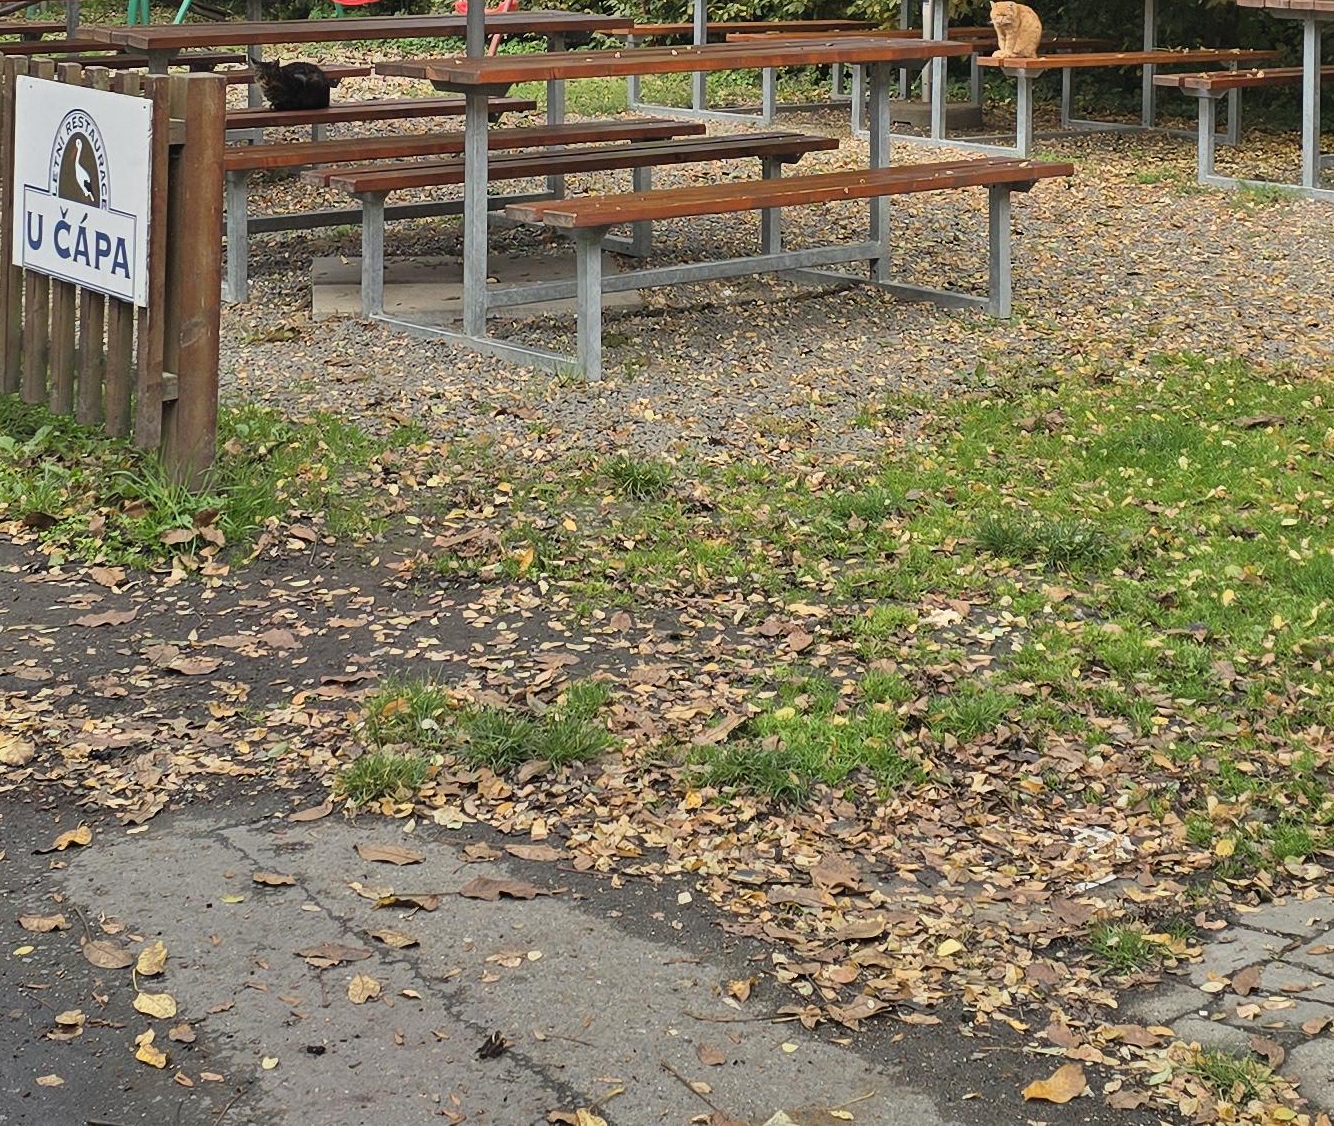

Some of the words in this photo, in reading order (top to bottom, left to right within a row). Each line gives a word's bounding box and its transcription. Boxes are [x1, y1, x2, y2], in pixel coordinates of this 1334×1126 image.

[65, 115, 108, 210] RESTAURACE
[27, 211, 44, 251] U
[53, 206, 131, 280] ČÁPA
